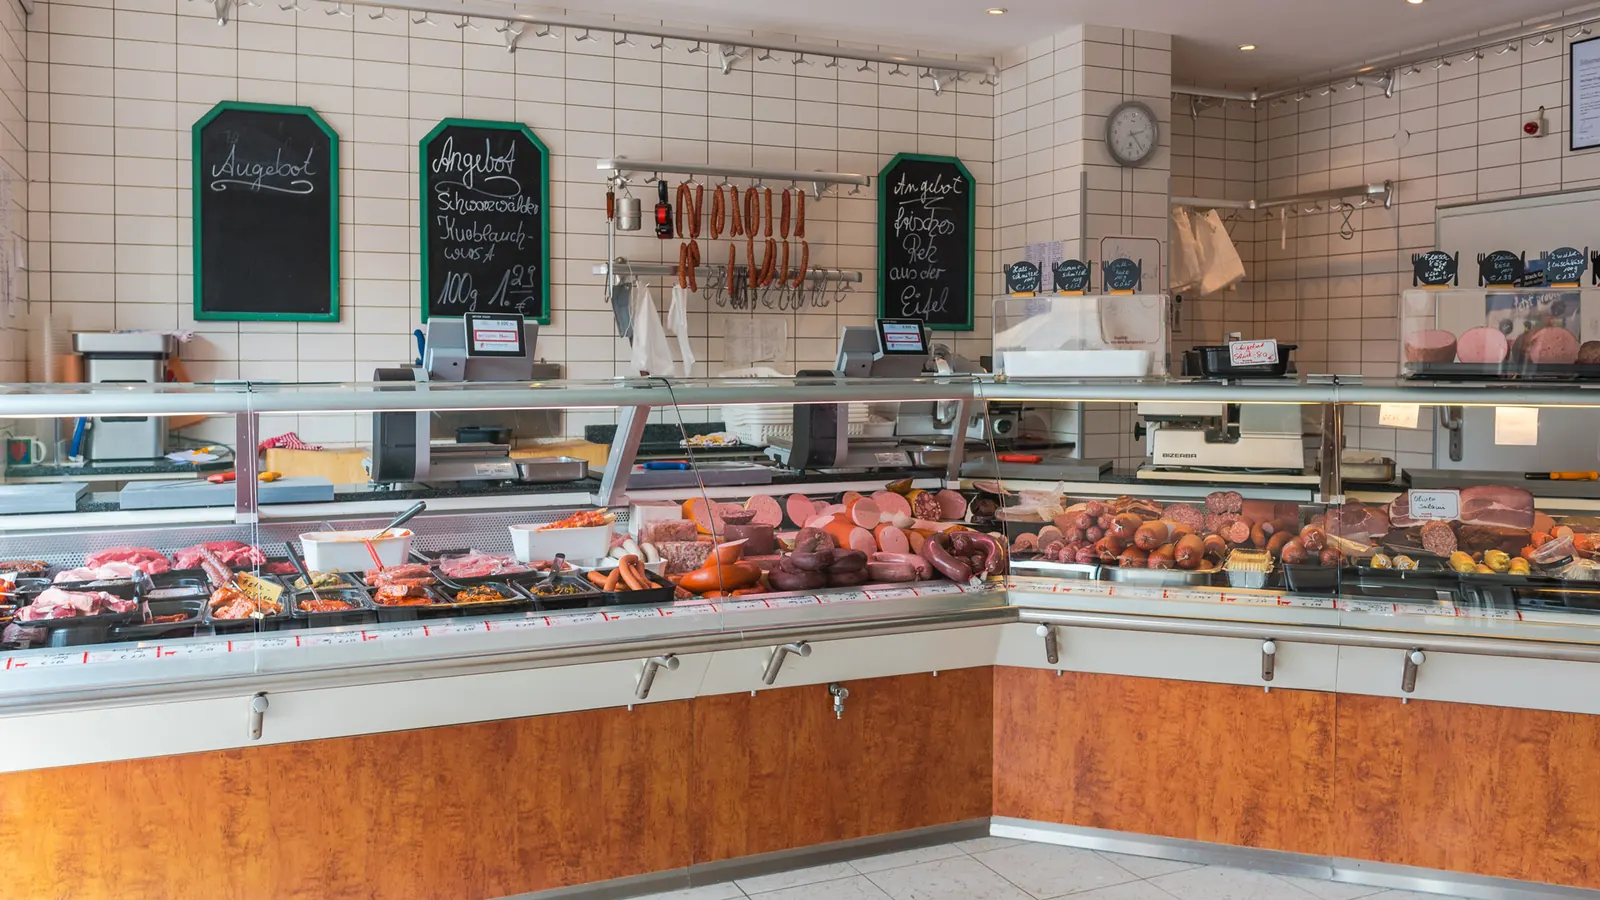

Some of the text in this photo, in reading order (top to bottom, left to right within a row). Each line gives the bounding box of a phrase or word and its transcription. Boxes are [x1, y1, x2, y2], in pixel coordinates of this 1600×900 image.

[211, 144, 316, 191] Angebot
[432, 136, 515, 189] Angebot
[437, 192, 539, 215] Schwarzwälder
[893, 172, 962, 204] Angebot
[437, 215, 534, 250] Knoblauch-
[894, 207, 955, 237] frisches
[444, 243, 496, 263] wurst
[903, 233, 940, 264] Reh
[889, 265, 946, 280] aus der
[437, 271, 478, 311] 100g
[901, 285, 949, 320] Eifel
